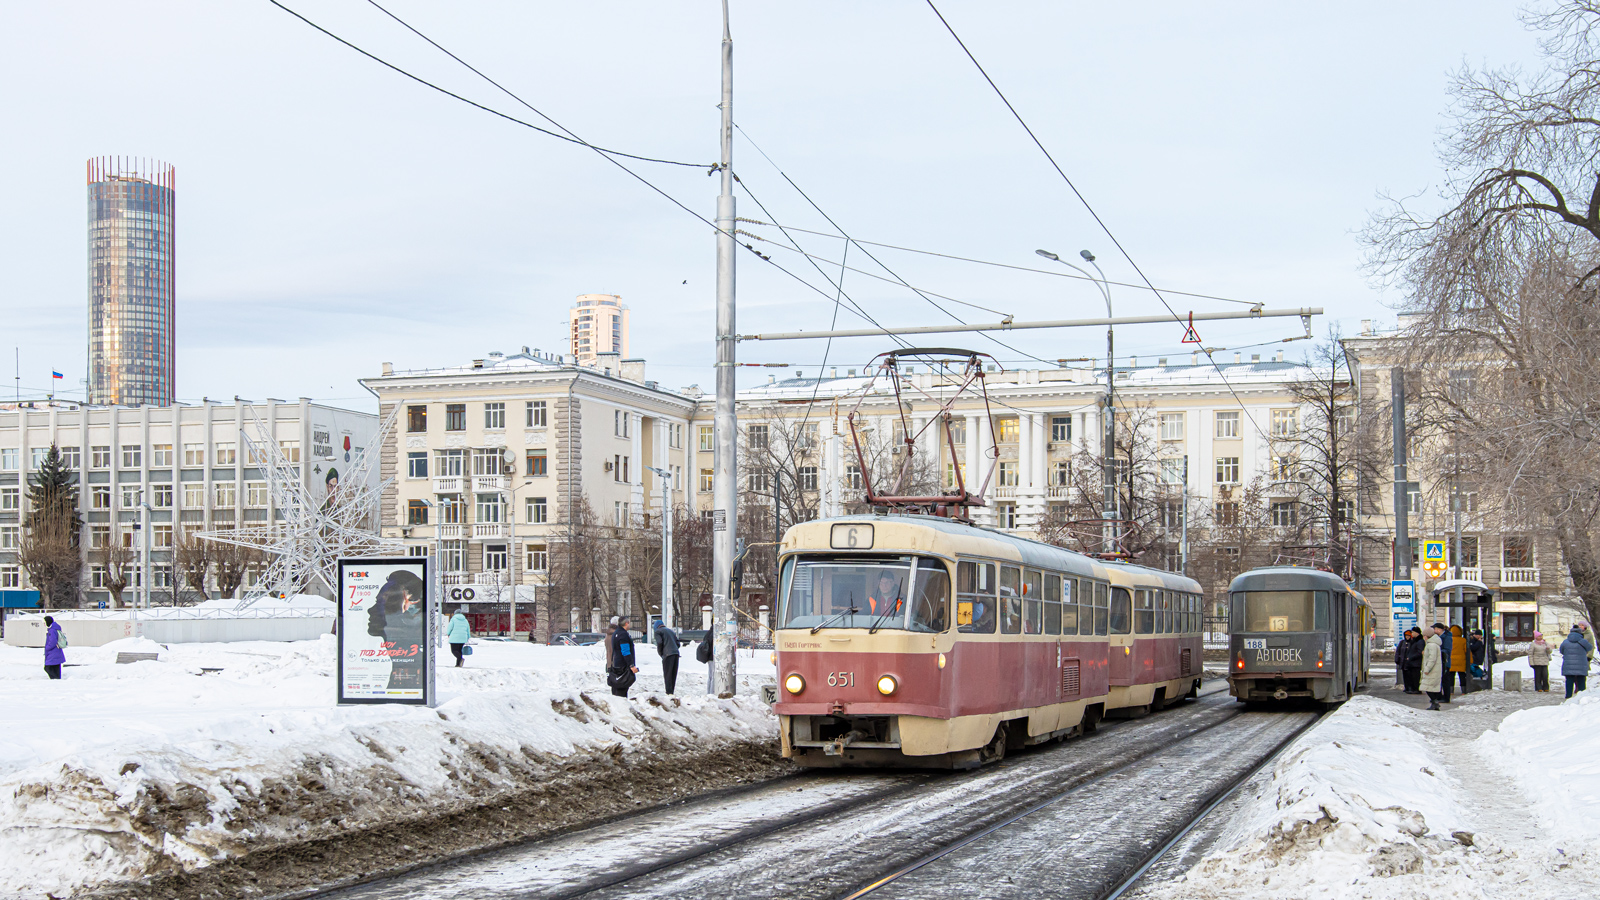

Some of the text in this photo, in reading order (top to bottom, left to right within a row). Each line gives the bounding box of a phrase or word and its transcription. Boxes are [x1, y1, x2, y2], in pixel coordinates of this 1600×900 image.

[847, 528, 858, 548] 6
[348, 585, 357, 599] 7
[450, 588, 475, 601] GO
[1272, 619, 1285, 631] 13
[359, 649, 376, 657] ПОД
[407, 644, 419, 657] 3
[380, 641, 397, 649] ШОУ
[1247, 641, 1263, 649] 188
[1256, 648, 1303, 662] АВТОВЕК
[827, 671, 855, 687] 651
